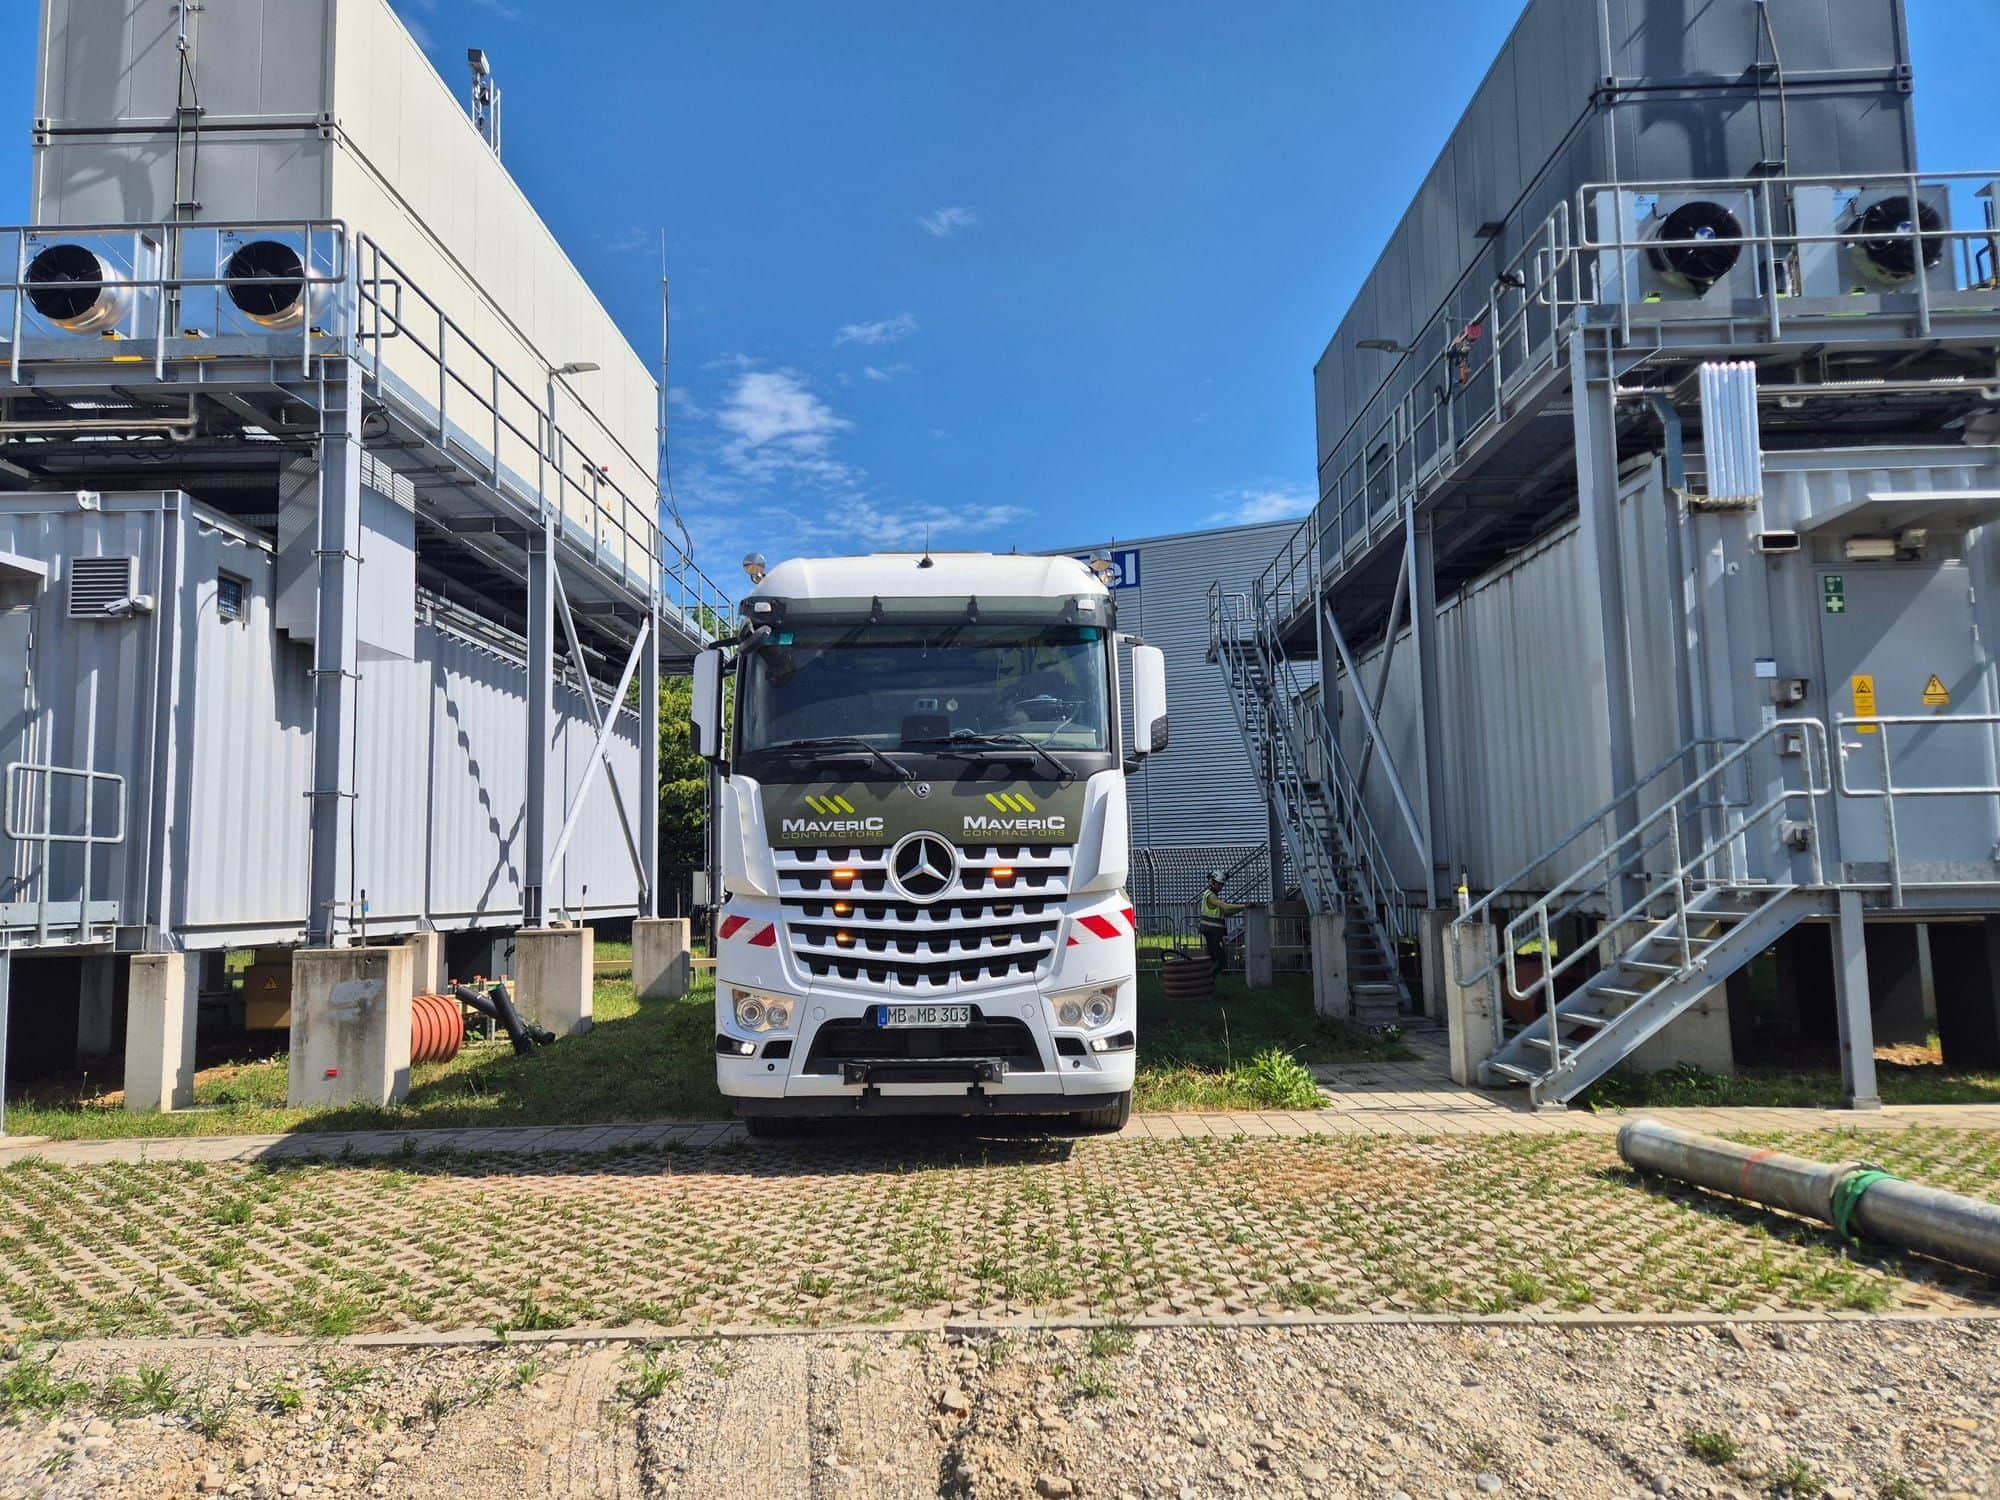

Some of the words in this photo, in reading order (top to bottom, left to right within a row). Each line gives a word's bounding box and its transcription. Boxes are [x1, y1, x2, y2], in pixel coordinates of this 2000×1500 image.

[781, 830, 884, 840] CONTRACTORS
[963, 829, 1065, 837] CONTRACTORS
[941, 1007, 969, 1023] 303
